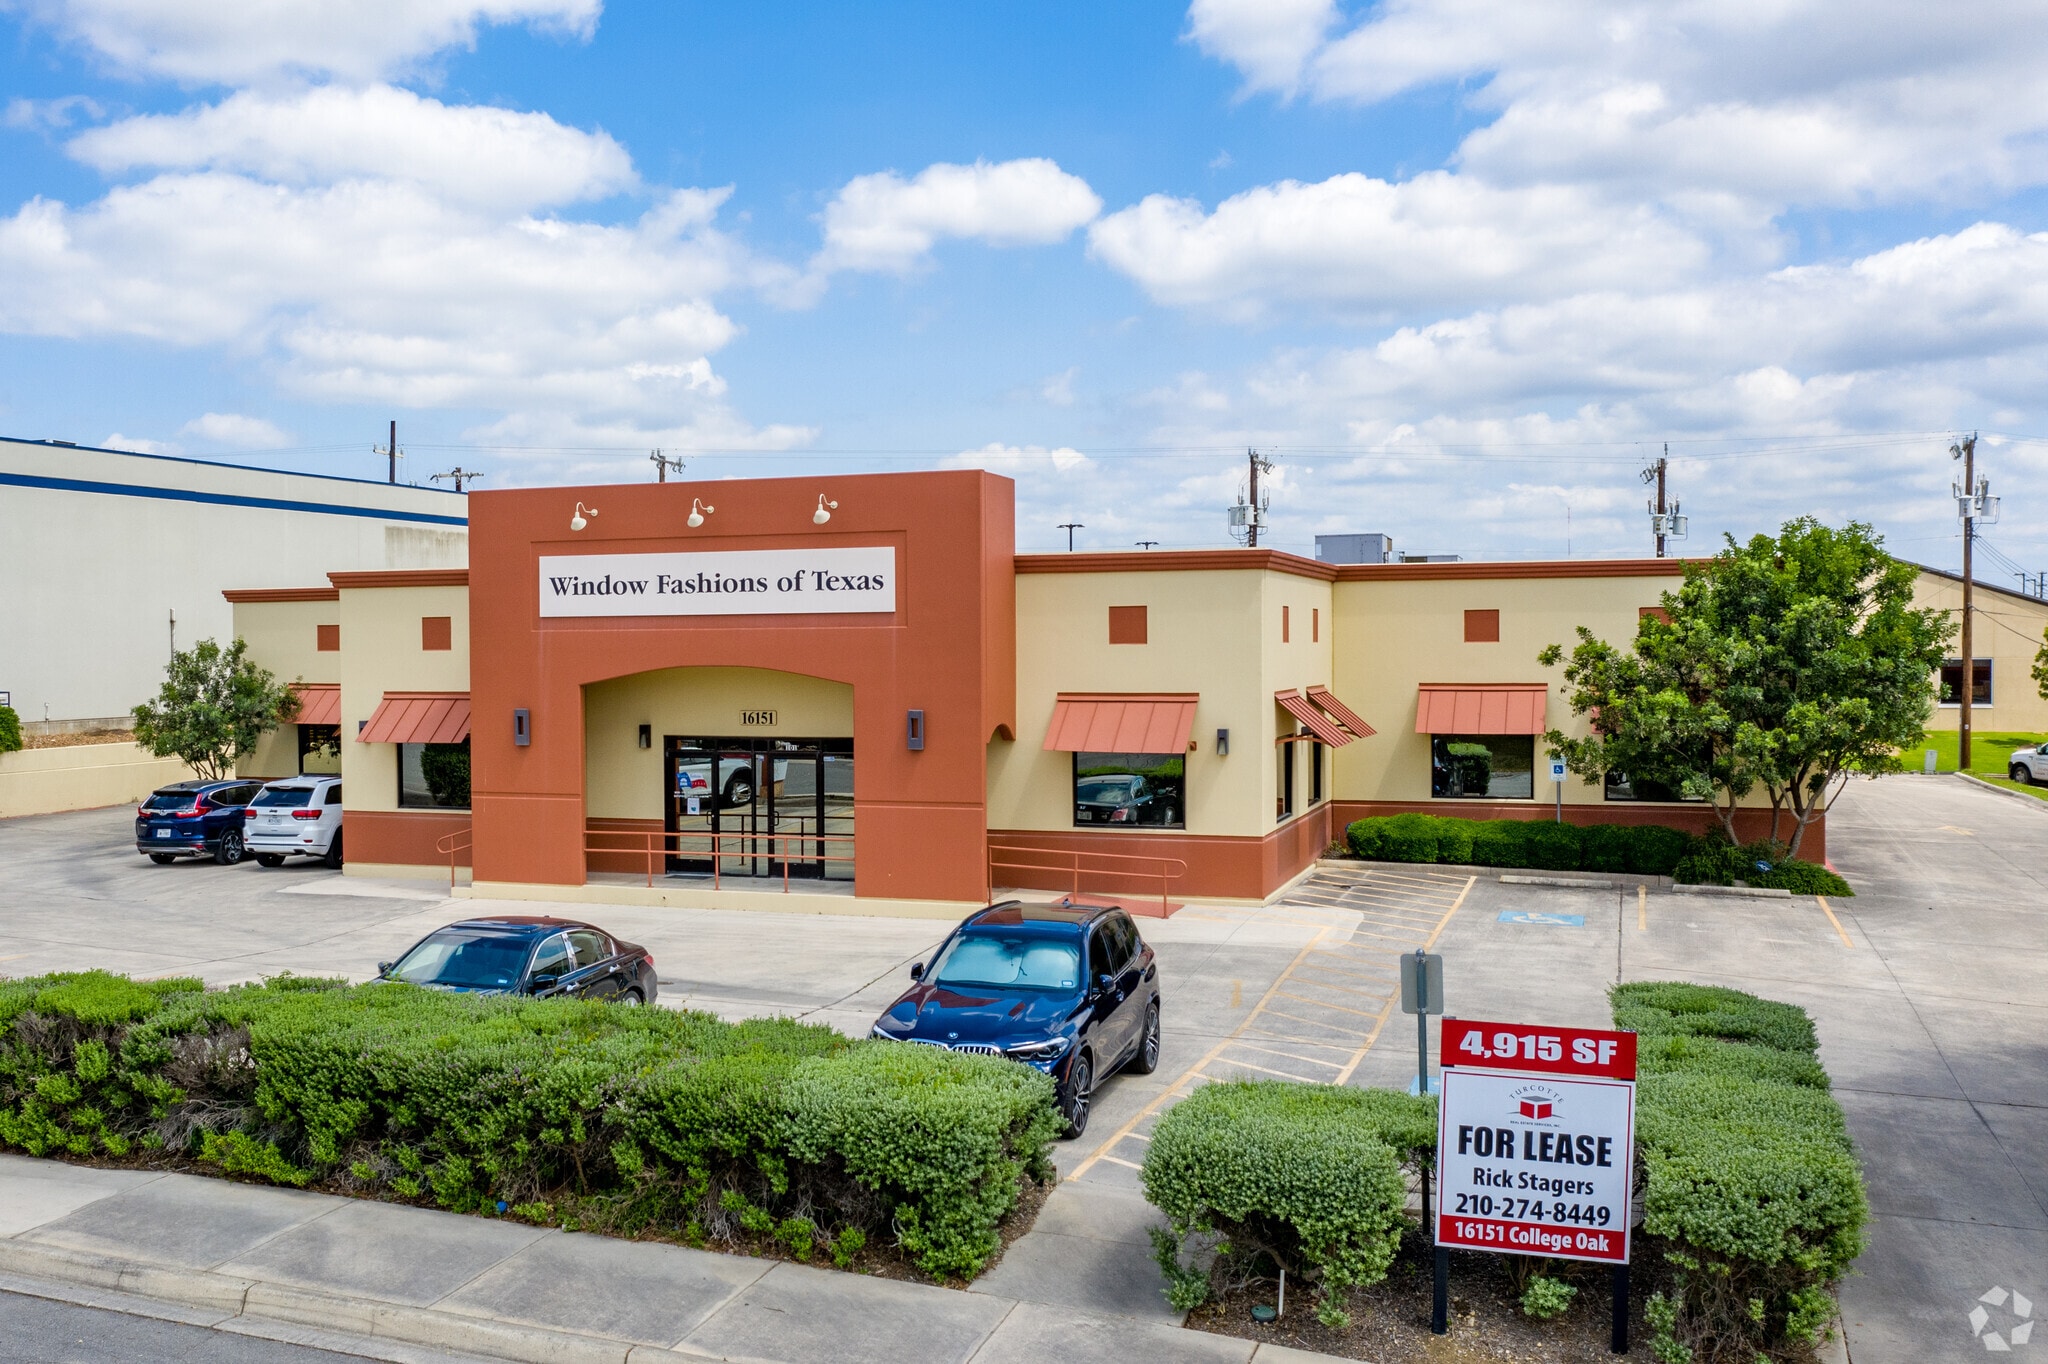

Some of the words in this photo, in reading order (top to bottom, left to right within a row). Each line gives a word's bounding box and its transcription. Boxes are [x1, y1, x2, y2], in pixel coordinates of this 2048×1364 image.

[549, 575, 649, 596] Window
[656, 571, 768, 594] Fashions
[776, 569, 806, 592] of
[811, 568, 885, 592] Texas
[741, 711, 774, 725] 16151
[1459, 1030, 1563, 1062] 4,915
[1571, 1038, 1618, 1065] SF
[1509, 1085, 1564, 1104] TURCOTTE
[1458, 1125, 1515, 1159] FOR
[1523, 1130, 1612, 1168] LEASE
[1473, 1167, 1514, 1189] Rick
[1518, 1171, 1594, 1197] Stagers
[1455, 1193, 1611, 1226] 210-274-8449
[1455, 1221, 1505, 1242] 16151
[1509, 1227, 1572, 1252] College
[1575, 1232, 1610, 1252] Oak
